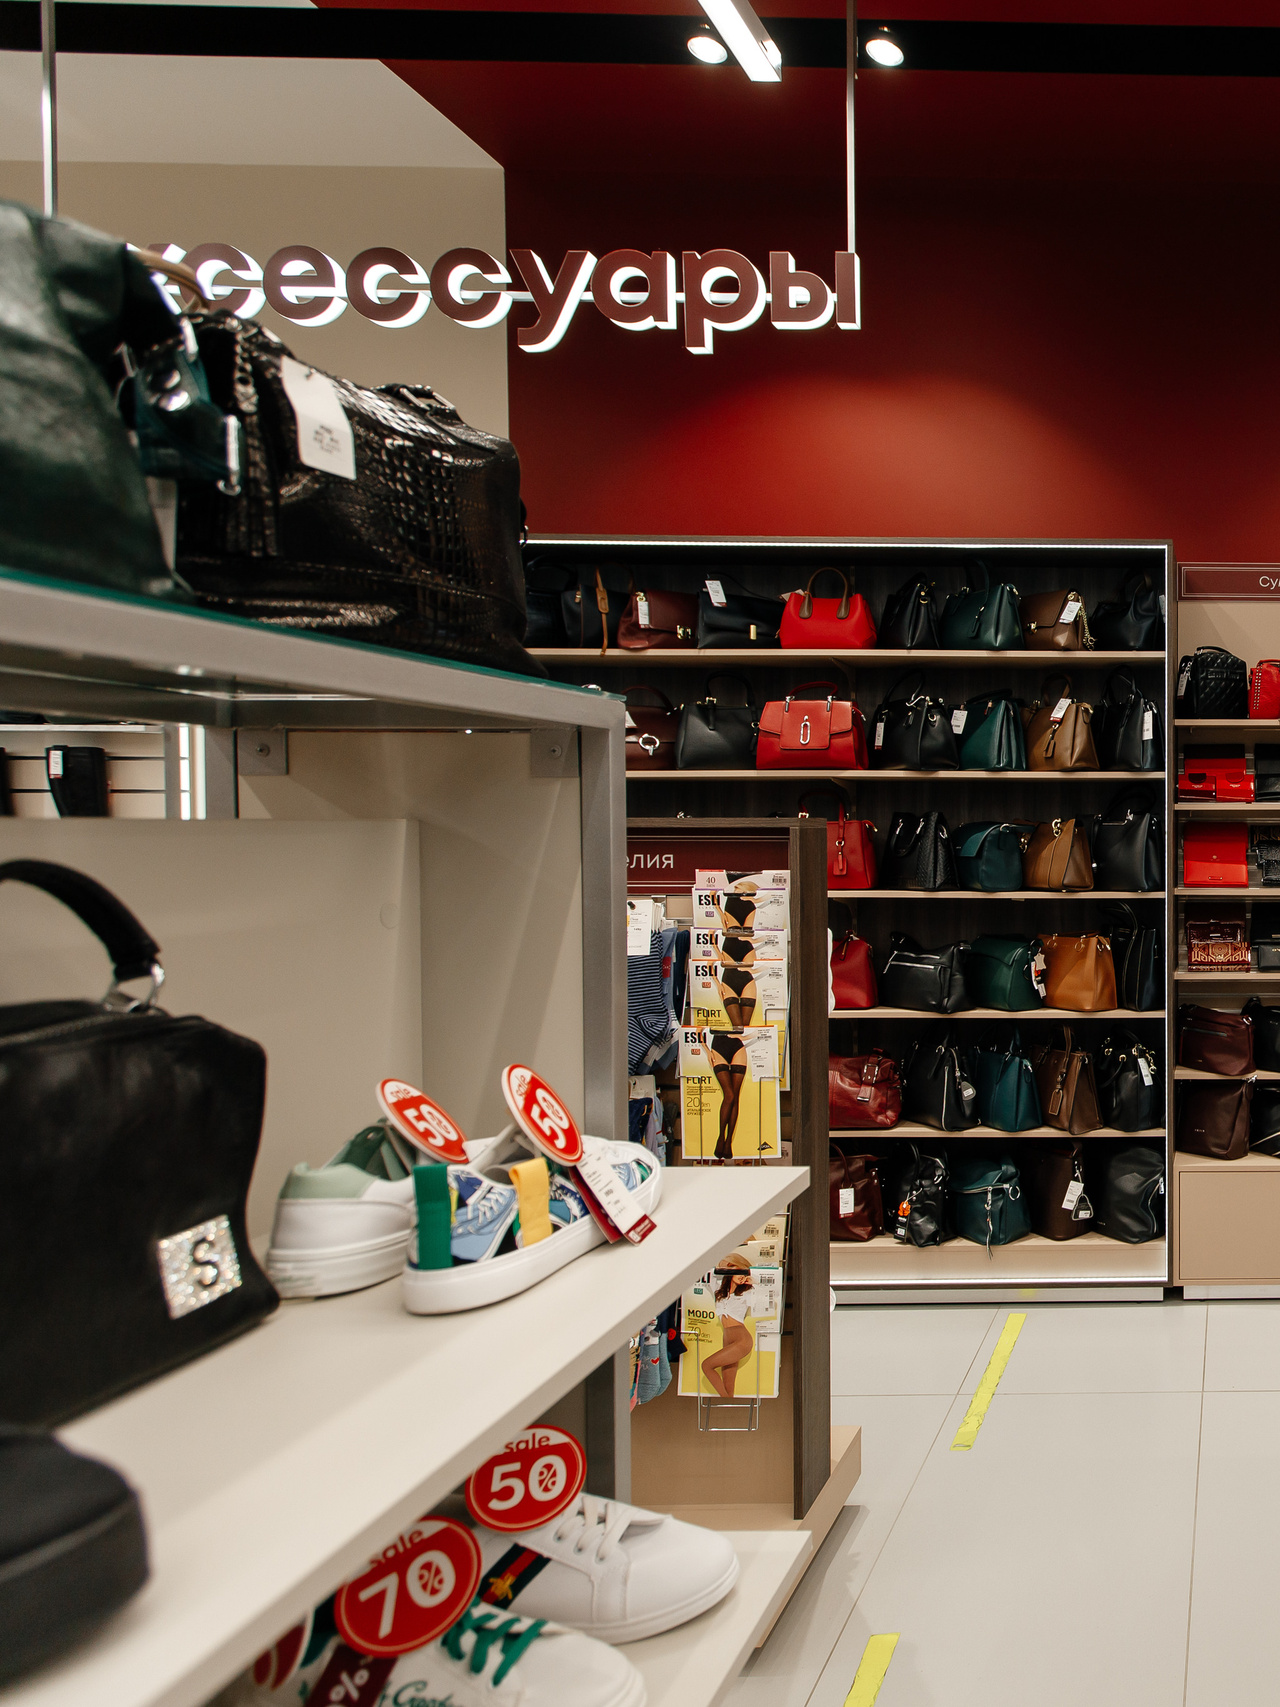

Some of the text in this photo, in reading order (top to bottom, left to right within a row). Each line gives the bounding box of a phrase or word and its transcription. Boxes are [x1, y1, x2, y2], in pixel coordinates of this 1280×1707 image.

[626, 854, 674, 869] лия
[705, 876, 716, 884] 40
[698, 894, 720, 906] ESLI
[696, 933, 719, 945] ESLI
[695, 964, 718, 977] ESLI
[696, 1009, 722, 1018] FLIRT
[684, 1032, 707, 1044] ESLI
[686, 1076, 712, 1085] FLIRT
[192, 1236, 220, 1288] S
[687, 1308, 716, 1320] MODO
[505, 1433, 551, 1455] sale
